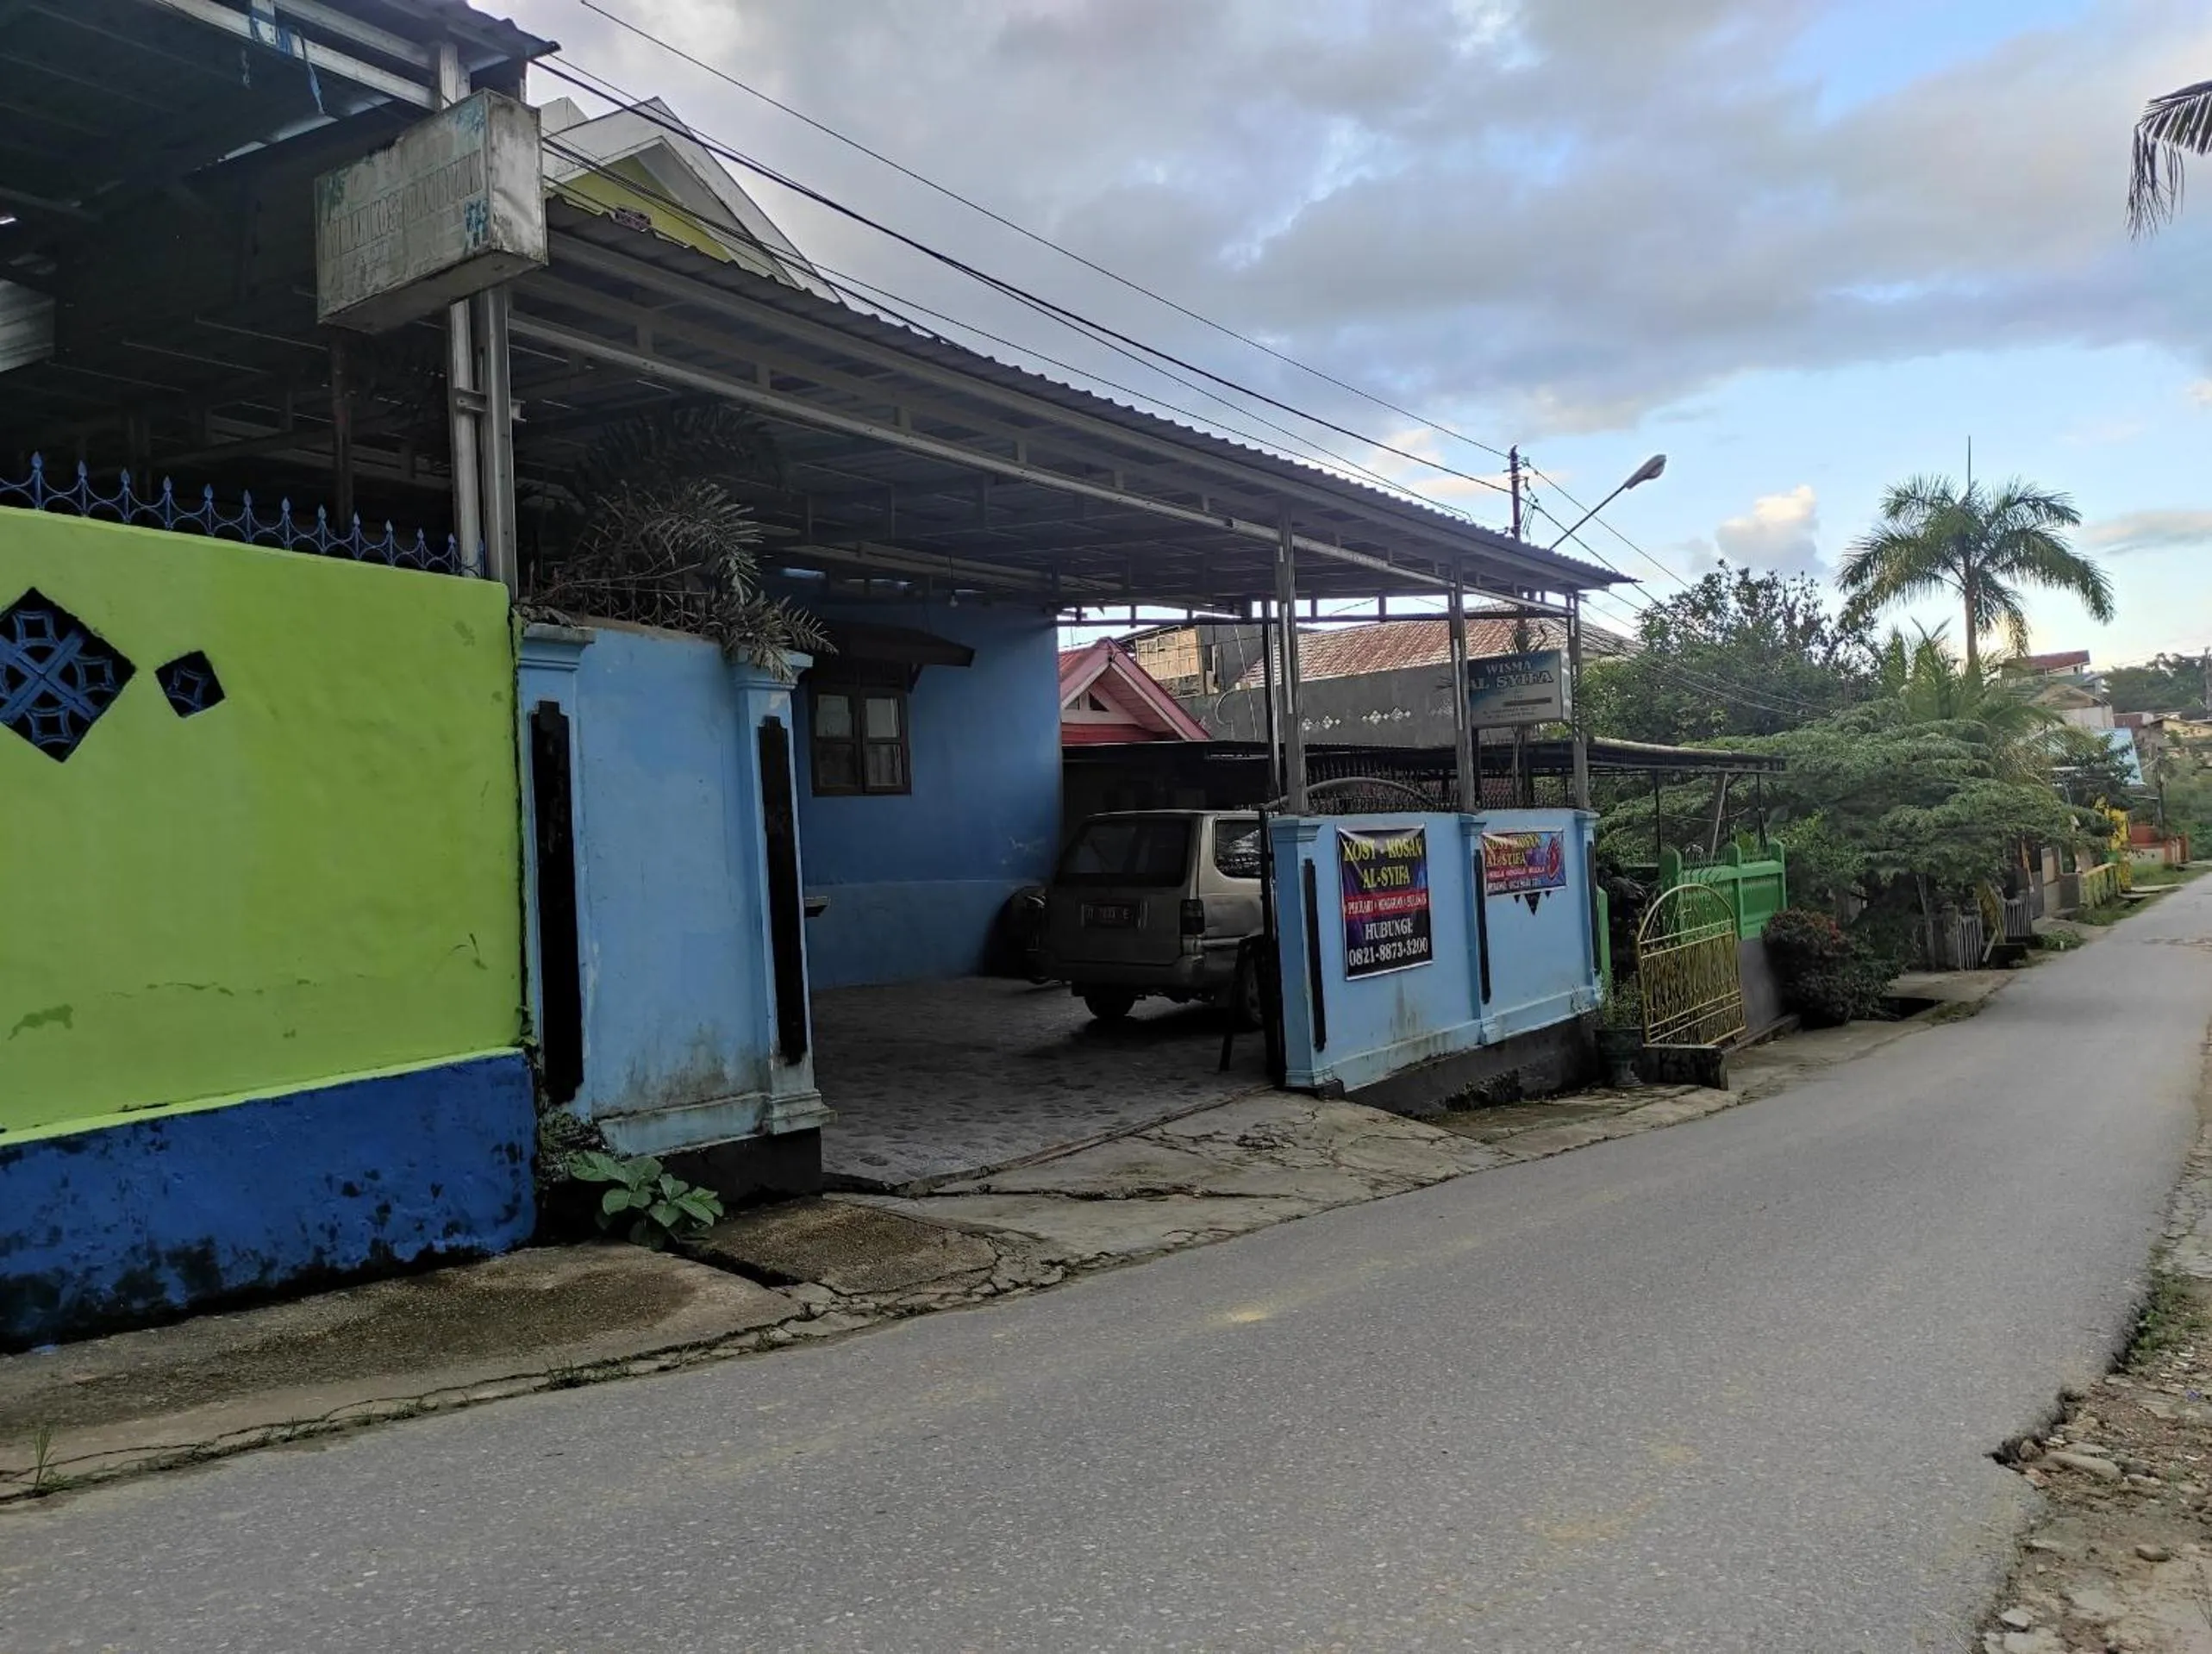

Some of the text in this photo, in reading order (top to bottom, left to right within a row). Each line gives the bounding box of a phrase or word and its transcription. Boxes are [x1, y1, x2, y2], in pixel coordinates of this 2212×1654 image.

[1485, 660, 1533, 674] WISMA
[1469, 670, 1554, 690] AL SYIFA
[1344, 839, 1377, 861] KOST
[1385, 837, 1423, 859] KOSAN
[1362, 865, 1411, 889] AL-SYIFA
